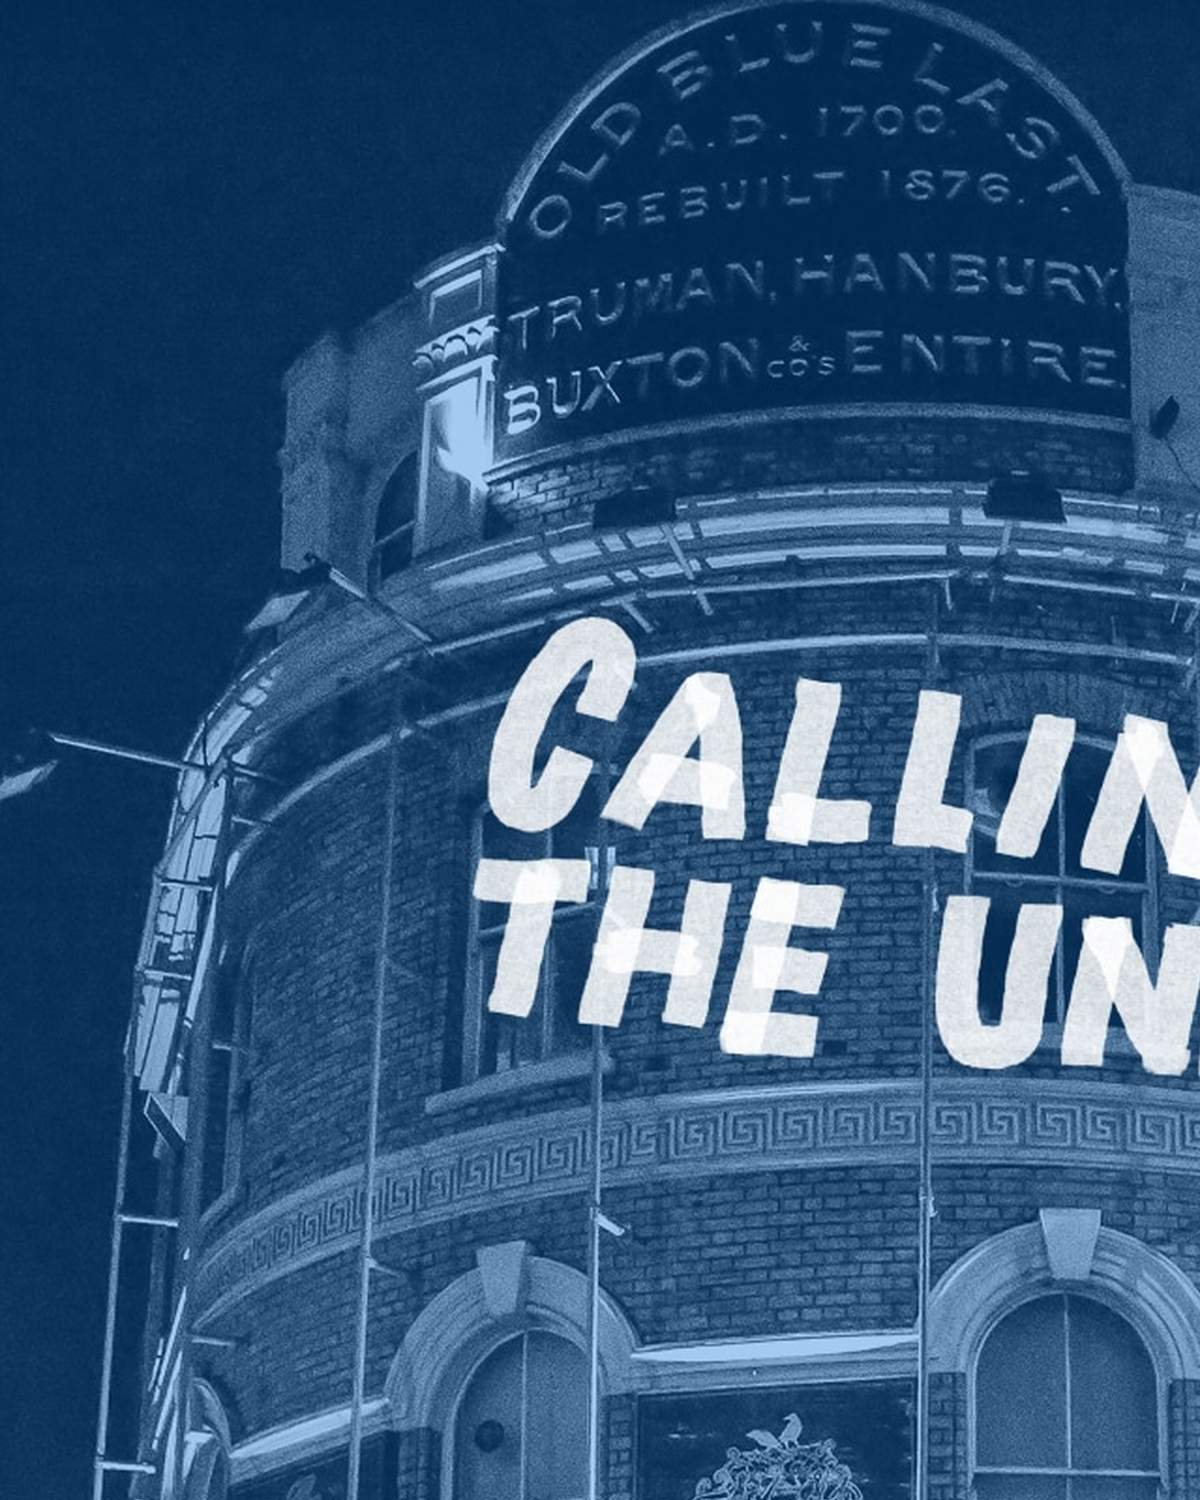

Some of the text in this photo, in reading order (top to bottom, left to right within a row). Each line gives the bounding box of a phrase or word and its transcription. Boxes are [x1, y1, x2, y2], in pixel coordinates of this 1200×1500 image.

[528, 101, 642, 239] OLD
[656, 20, 892, 103] BLUE
[596, 169, 847, 235] REBUILT
[504, 338, 760, 436] BUXTON
